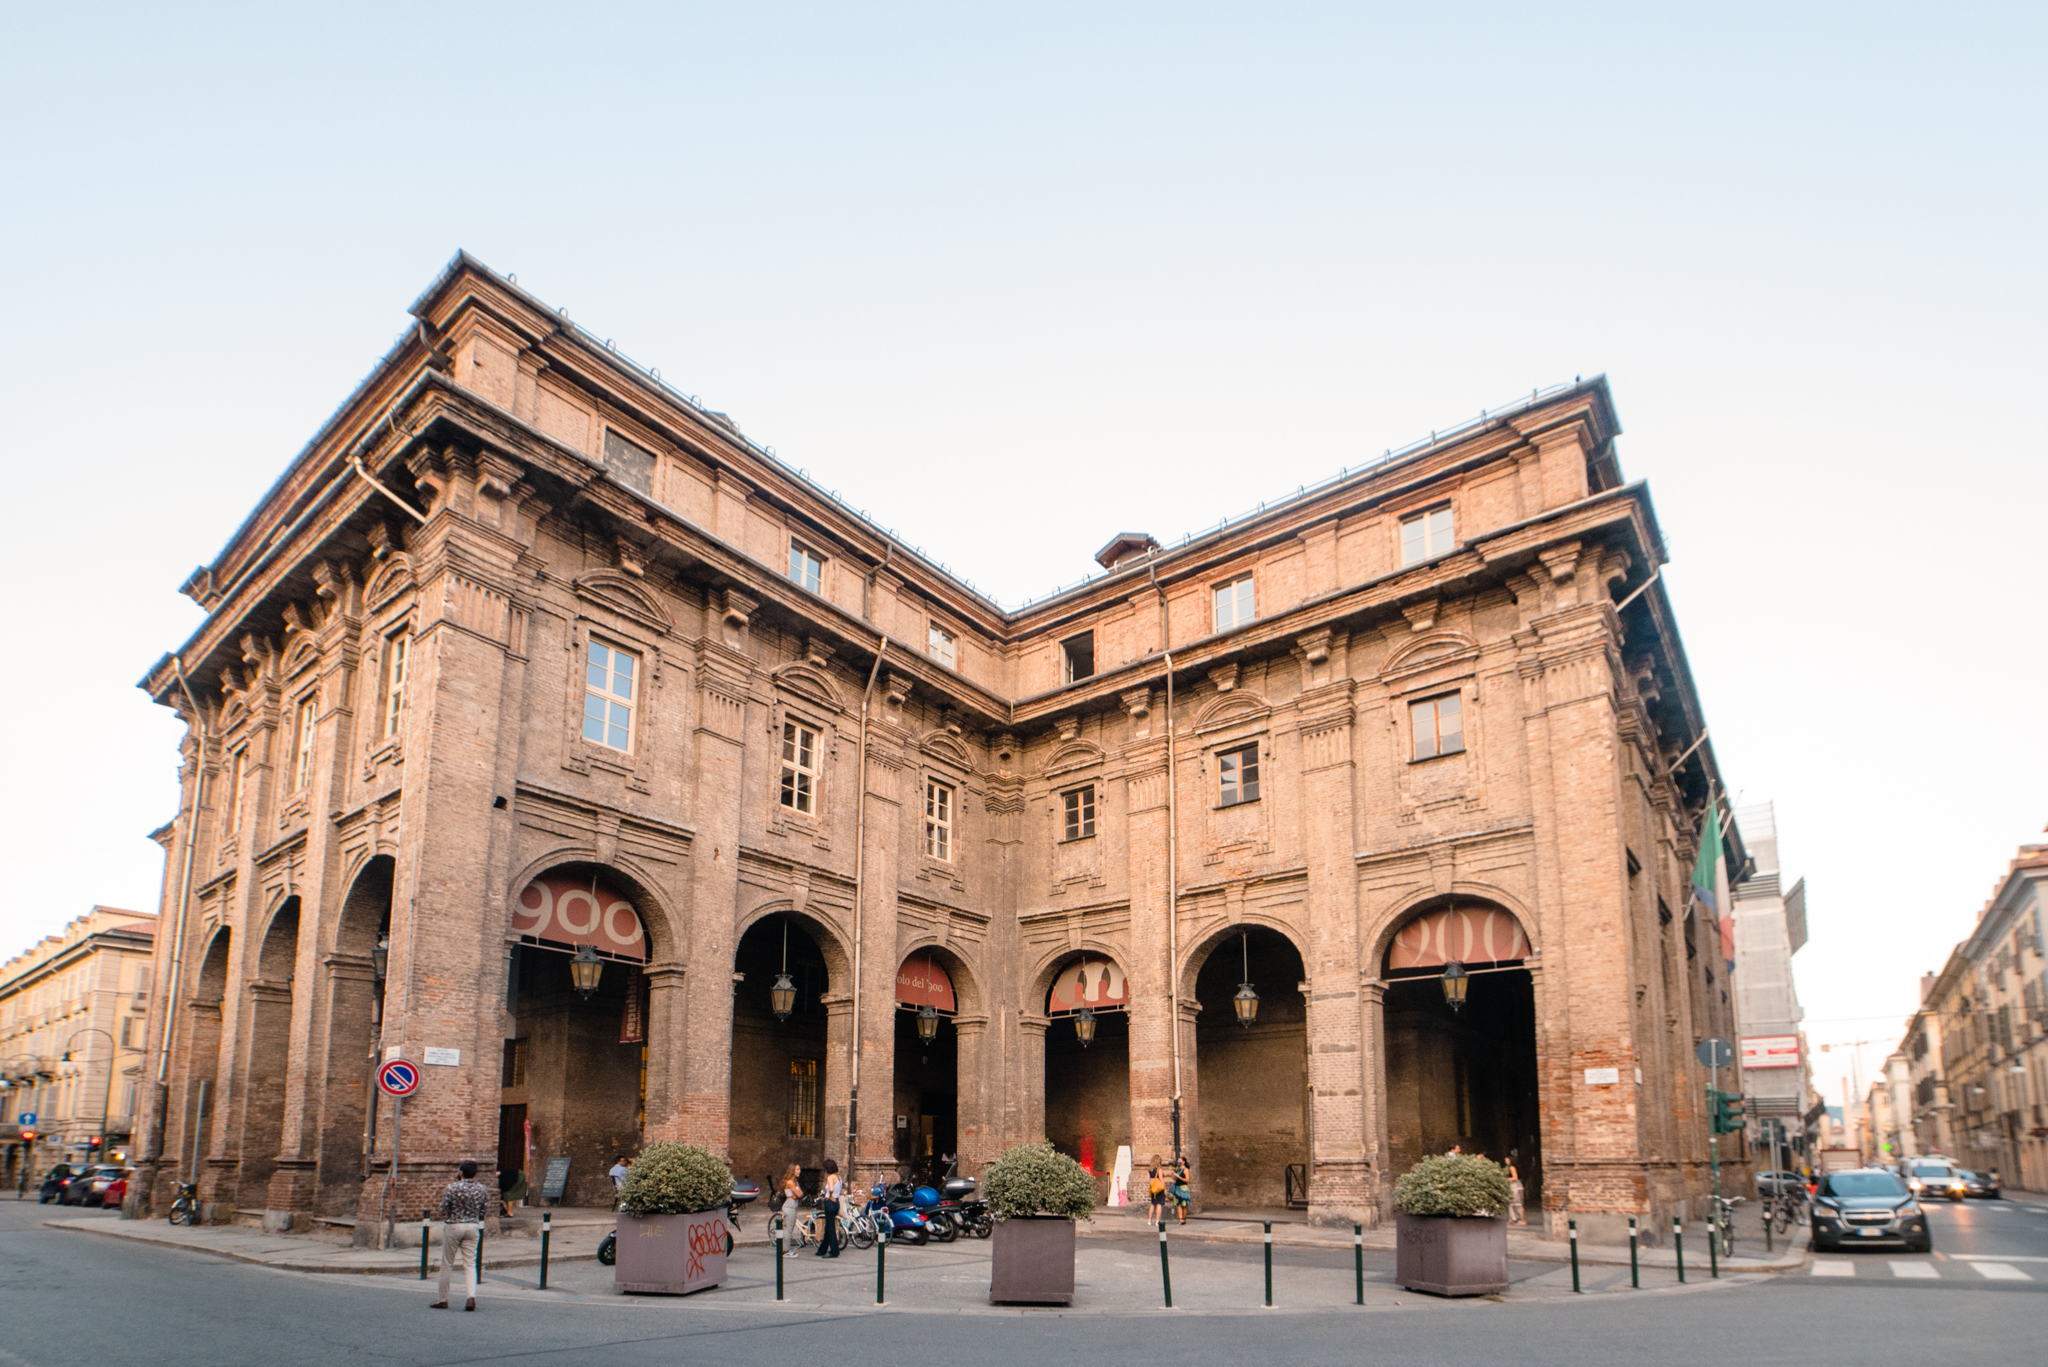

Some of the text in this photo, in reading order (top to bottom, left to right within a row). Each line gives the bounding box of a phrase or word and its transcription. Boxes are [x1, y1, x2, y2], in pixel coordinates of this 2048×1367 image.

[511, 879, 643, 945] 900
[897, 974, 910, 986] olo
[912, 976, 924, 988] del
